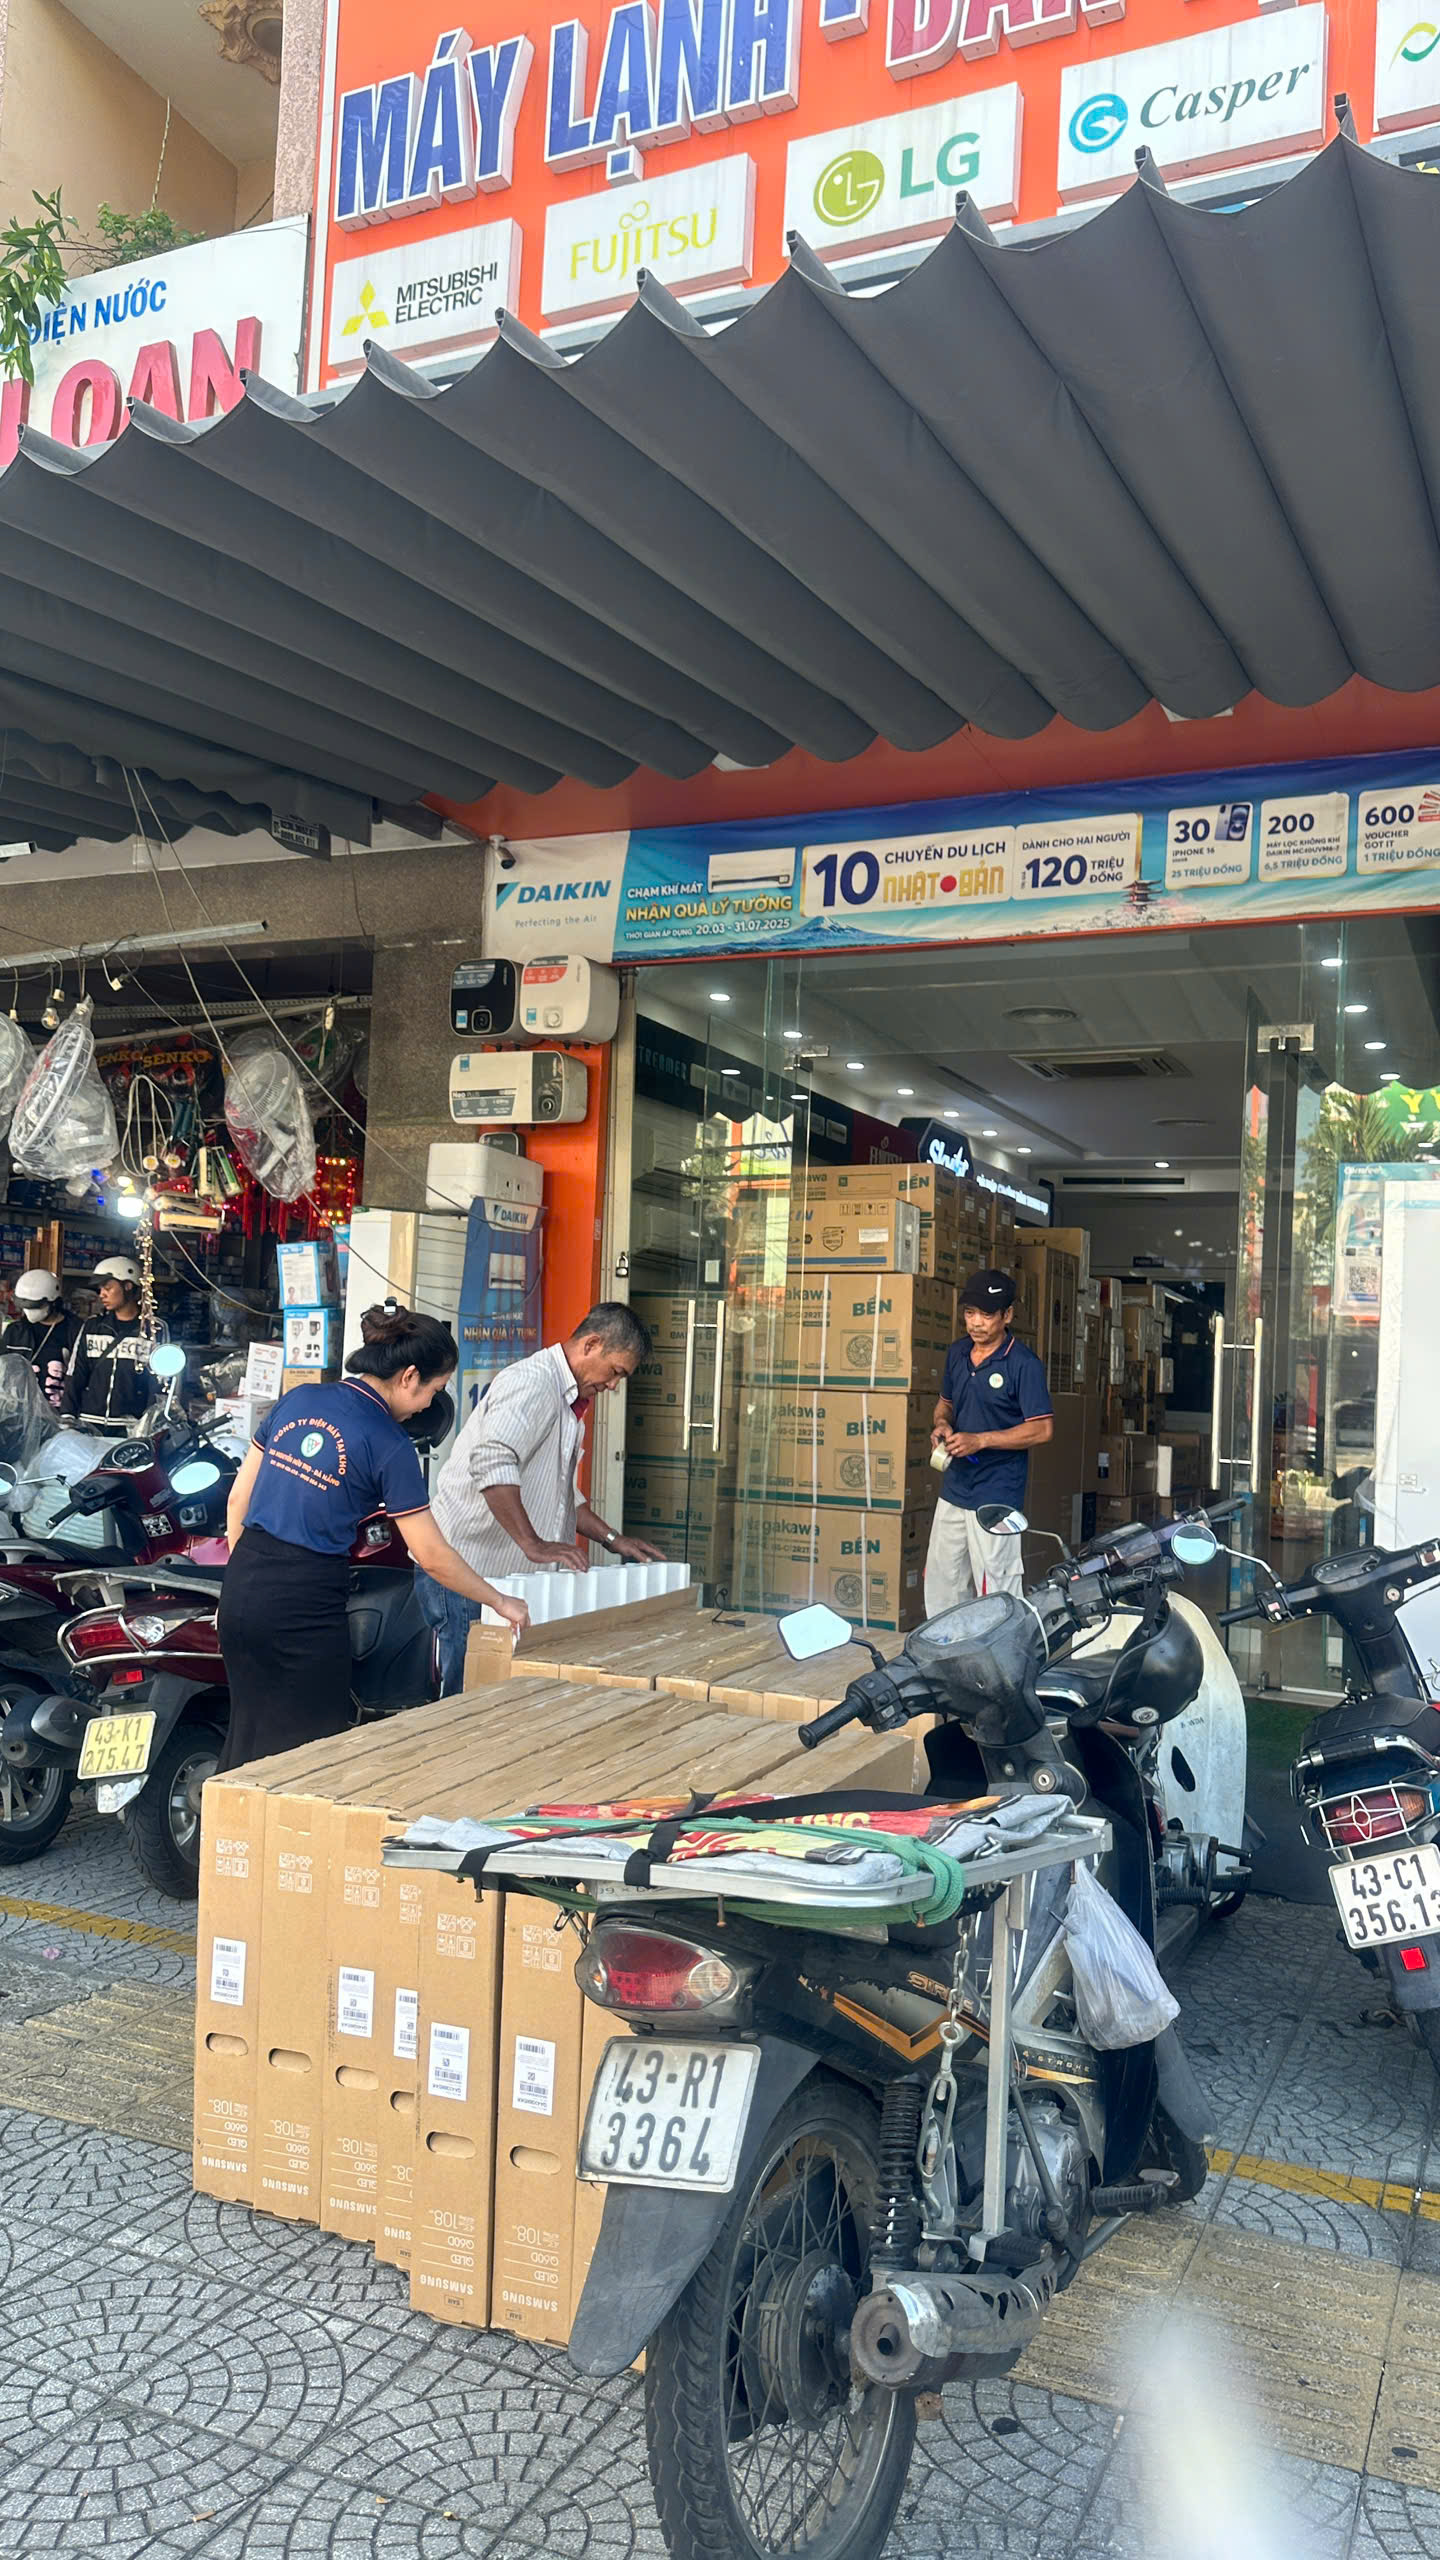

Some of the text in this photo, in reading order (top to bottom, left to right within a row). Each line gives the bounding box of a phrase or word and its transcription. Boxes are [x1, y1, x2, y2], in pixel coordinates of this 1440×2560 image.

[1140, 61, 1311, 129] Casper
[335, 0, 798, 230] MÁY LẠNH
[900, 132, 980, 199] LG
[570, 206, 718, 281] FUJITSU
[396, 262, 498, 305] MITSUBISHI
[94, 278, 167, 328] NƯỚC
[395, 286, 484, 324] ELECTRIC
[1268, 813, 1315, 835] 200
[1365, 804, 1415, 827] 600
[1022, 830, 1131, 850] DÀNH CHO HAI NGƯỜI
[1174, 818, 1210, 843] 30
[1365, 830, 1409, 840] VOUCHER
[1364, 840, 1394, 849] GOT IT
[1364, 853, 1369, 862] 1
[1372, 849, 1404, 863] TRIỆU
[1025, 854, 1088, 889] 120
[1090, 856, 1125, 872] TRIỆU
[1184, 865, 1211, 879] TRIỆU
[1213, 863, 1243, 875] ĐỒNG
[1281, 857, 1309, 870] TRIỆU
[1311, 854, 1343, 866] ĐỒNG
[812, 841, 1006, 907] 10 CHUYẾN DU LỊCH
[883, 871, 941, 905] NHẬT
[958, 858, 1005, 898] BẢN
[1090, 871, 1123, 884] ĐỒNG
[517, 880, 611, 904] DAIKIN
[627, 881, 703, 900] CHẠM KHÍ MÁT
[626, 893, 793, 924] NHẬN QUÀ LÝ TƯỞNG
[515, 917, 561, 929] Perfecting
[565, 914, 580, 925] the
[696, 922, 725, 936] 20.03
[735, 918, 791, 932] 31.07.2025
[297, 1418, 308, 1426] TY
[337, 1454, 347, 1476] KHO
[94, 1718, 143, 1745] 43-K1
[84, 1743, 145, 1773] 275.47
[1350, 1854, 1427, 1900] 43-C1
[615, 2048, 727, 2109] 43-R1
[227, 2136, 248, 2149] QLED
[600, 2112, 712, 2176] 3364
[201, 2155, 248, 2174] SAMSUNG
[288, 2158, 310, 2171] QLED
[262, 2176, 310, 2196] SAMSUNG
[433, 2210, 458, 2229] 108
[447, 2235, 475, 2250] Q60D
[516, 2225, 543, 2246] 108
[451, 2253, 474, 2267] QLED
[530, 2251, 559, 2266] Q60D
[420, 2273, 474, 2296] SAMSUNG
[534, 2270, 559, 2284] QLED
[502, 2290, 559, 2313] SAMSUNG
